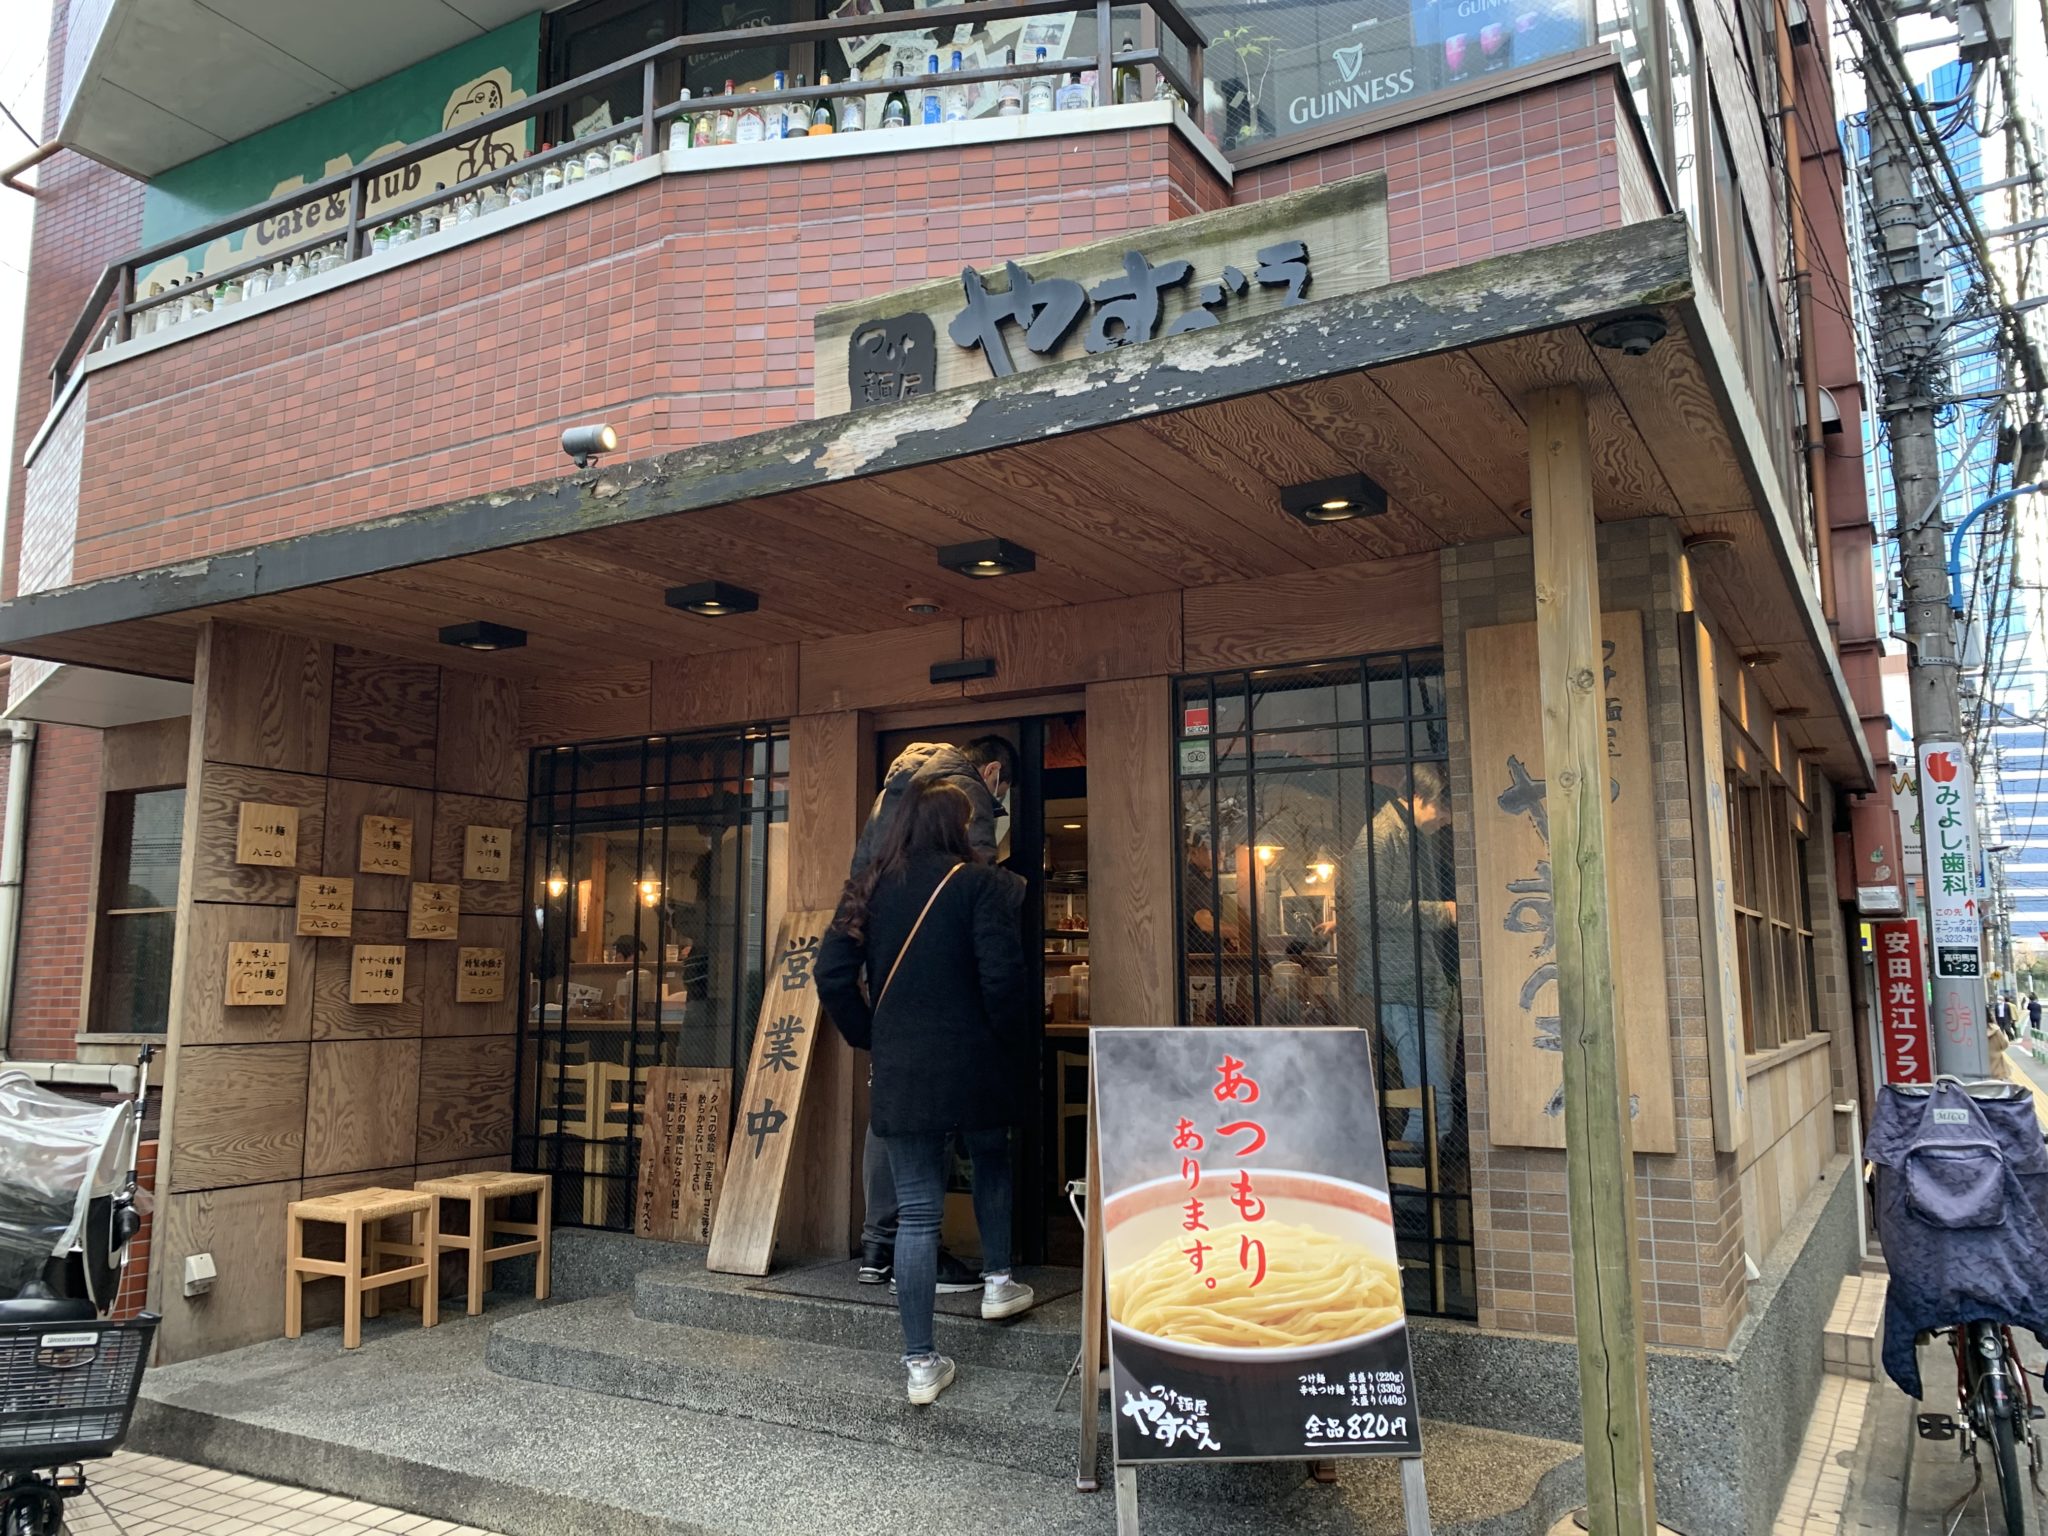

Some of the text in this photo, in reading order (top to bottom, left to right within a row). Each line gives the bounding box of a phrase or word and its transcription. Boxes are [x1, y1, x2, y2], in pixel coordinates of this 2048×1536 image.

[1289, 68, 1415, 125] GUINNESS
[325, 191, 347, 222] &
[349, 163, 422, 204] lub
[253, 825, 286, 837] つけ麺
[373, 840, 402, 851] つけ麺
[1936, 785, 1968, 897] みよし歯科
[476, 850, 502, 859] つけ麺
[310, 900, 345, 911] らーめん
[422, 903, 453, 914] らーめん
[1936, 908, 1963, 917] この先
[235, 959, 287, 967] チャーシュー
[1943, 953, 1977, 963] 高田馬場
[365, 969, 394, 978] つけ麺
[1947, 963, 1977, 972] 1-22
[243, 969, 277, 979] つけ麺
[1884, 931, 1919, 1084] 安田光江フラ
[746, 936, 820, 1161] 営業中
[1213, 1055, 1267, 1289] あつもり
[1172, 1117, 1217, 1290] あります。
[1298, 1372, 1326, 1385] つけ麺
[1299, 1383, 1346, 1396] 辛味つけ麺
[1121, 1390, 1221, 1451] やすべえ
[1305, 1412, 1408, 1440] 全品820円
